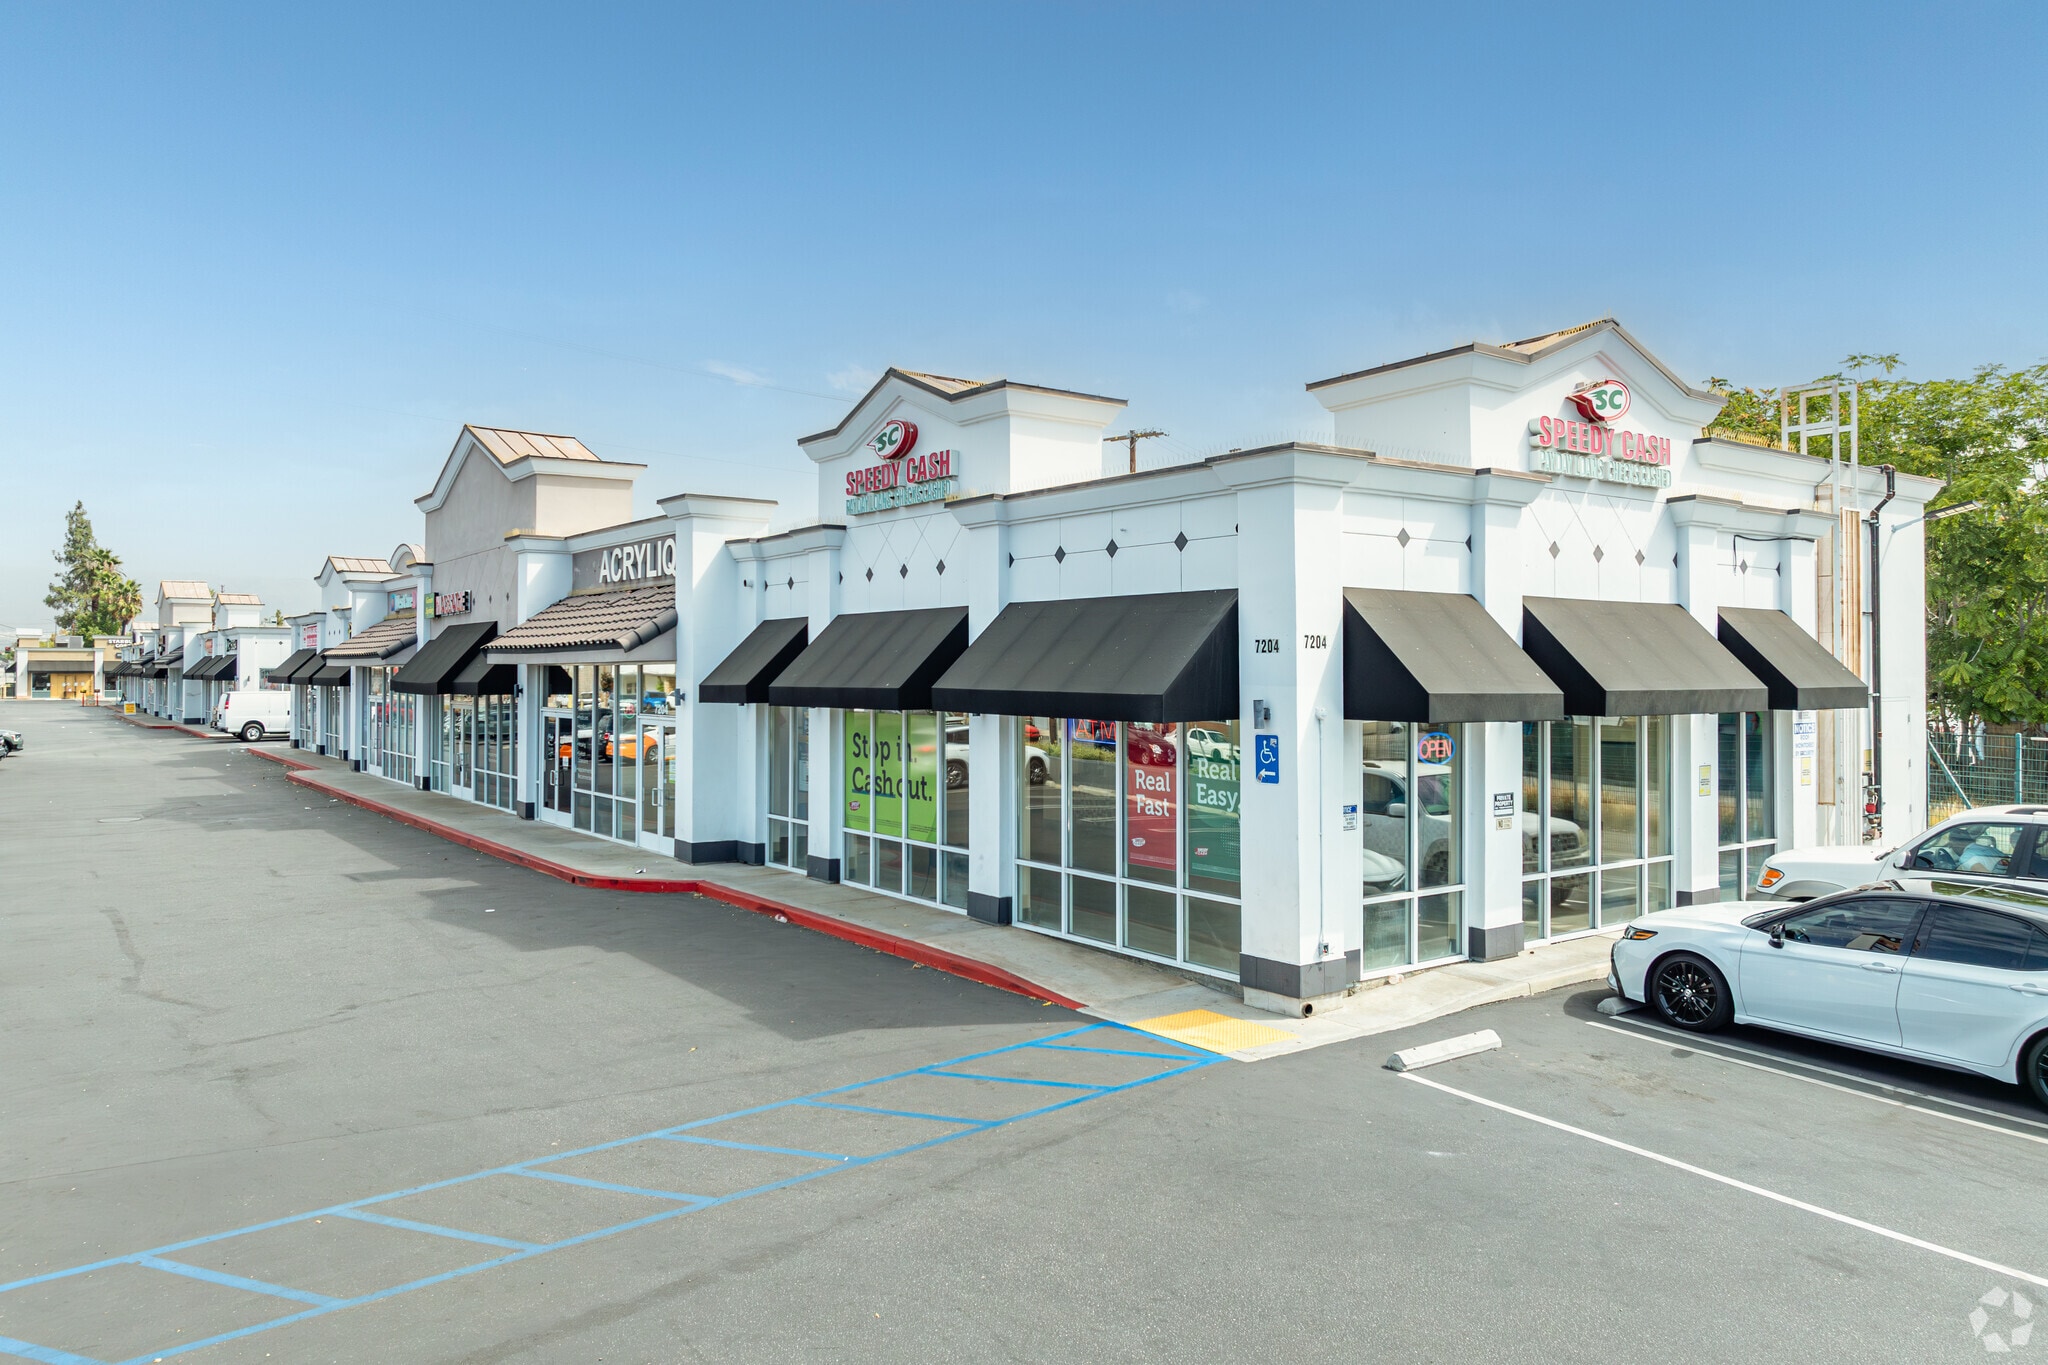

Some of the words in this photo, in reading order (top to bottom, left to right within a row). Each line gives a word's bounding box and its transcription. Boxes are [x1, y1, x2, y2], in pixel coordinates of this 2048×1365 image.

[1588, 389, 1623, 410] SC
[875, 426, 900, 452] SC
[1539, 415, 1614, 456] SPEEDY
[1621, 431, 1671, 466] CASH
[845, 461, 900, 496] SPEEDY
[906, 449, 951, 483] CASH
[599, 538, 676, 583] ACRYLIQ
[1255, 639, 1279, 653] 7204
[1304, 634, 1327, 649] 7204
[1075, 719, 1116, 741] ATM
[1420, 739, 1452, 759] OPEN
[852, 766, 894, 795] Cash
[1135, 769, 1171, 792] Real
[1197, 757, 1237, 781] Real
[1136, 794, 1170, 817] Fast
